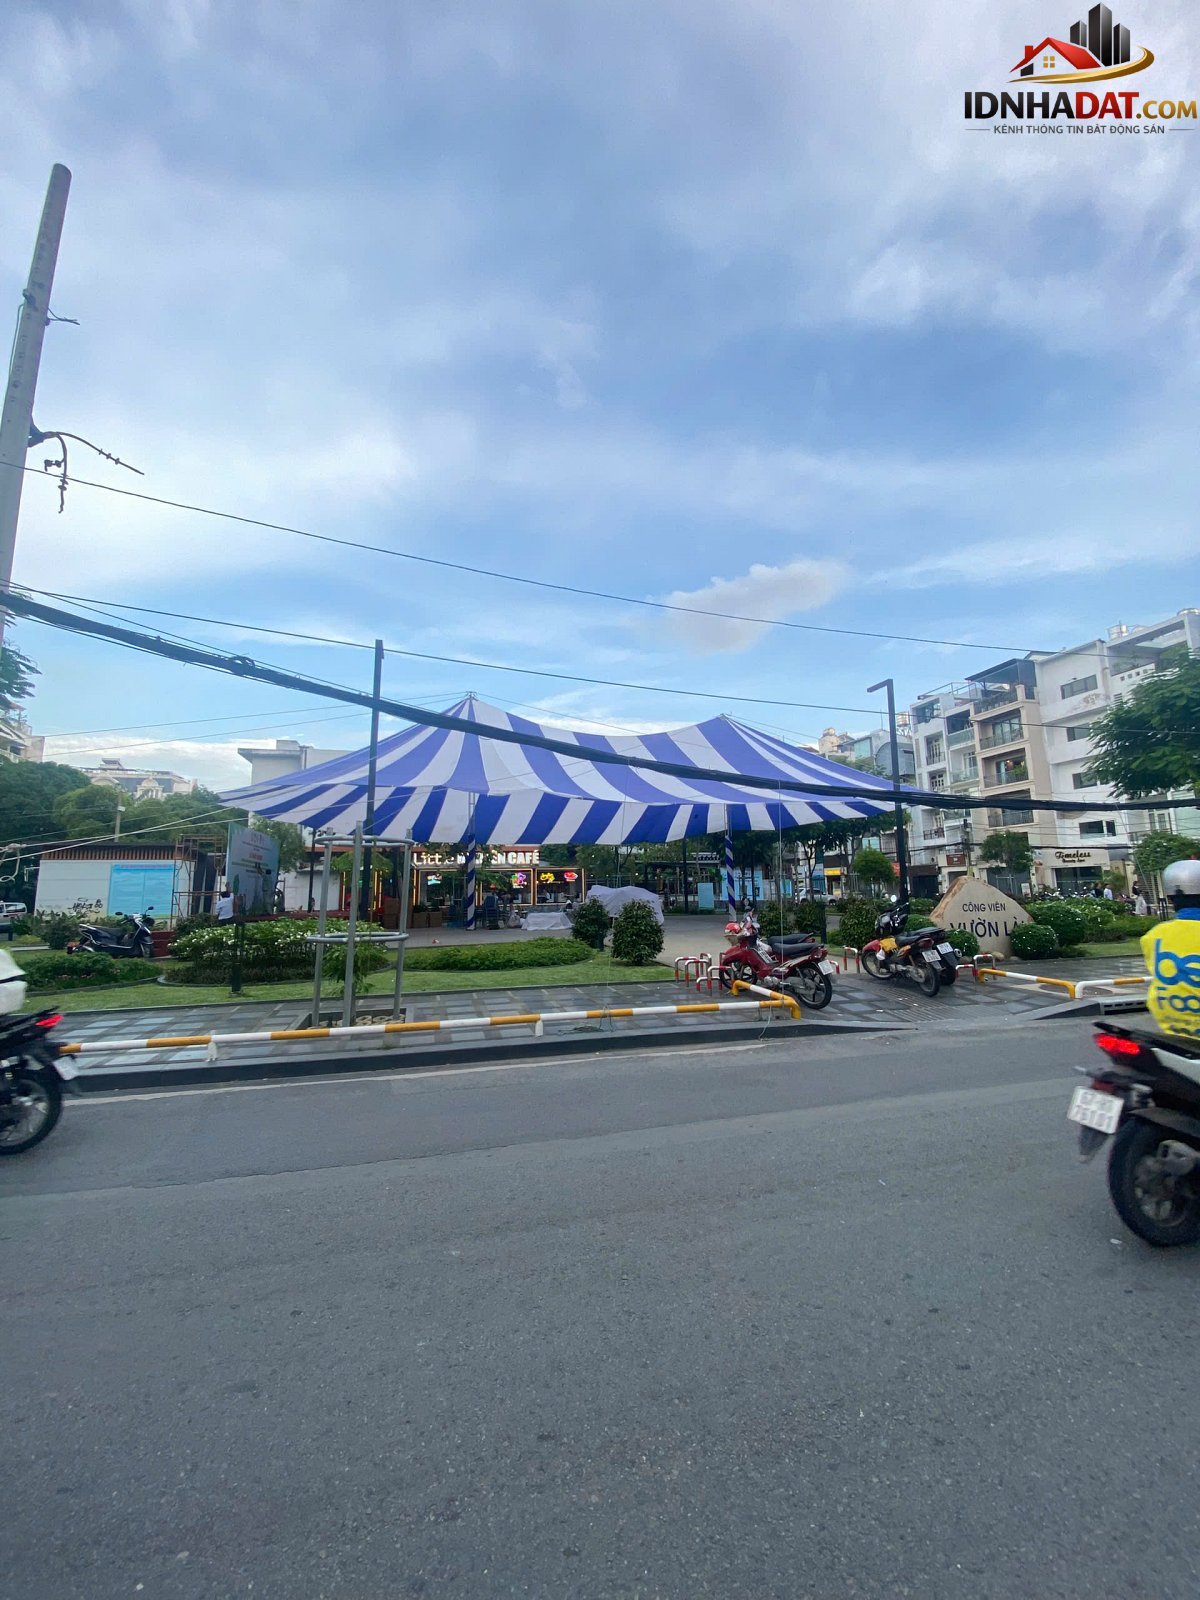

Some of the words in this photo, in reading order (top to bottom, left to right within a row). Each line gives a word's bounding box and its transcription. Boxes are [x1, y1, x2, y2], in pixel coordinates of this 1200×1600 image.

[507, 850, 540, 865] CAFÉ
[1054, 850, 1091, 860] Timeless
[962, 901, 986, 912] CÔNG
[988, 901, 1006, 912] VIÊN
